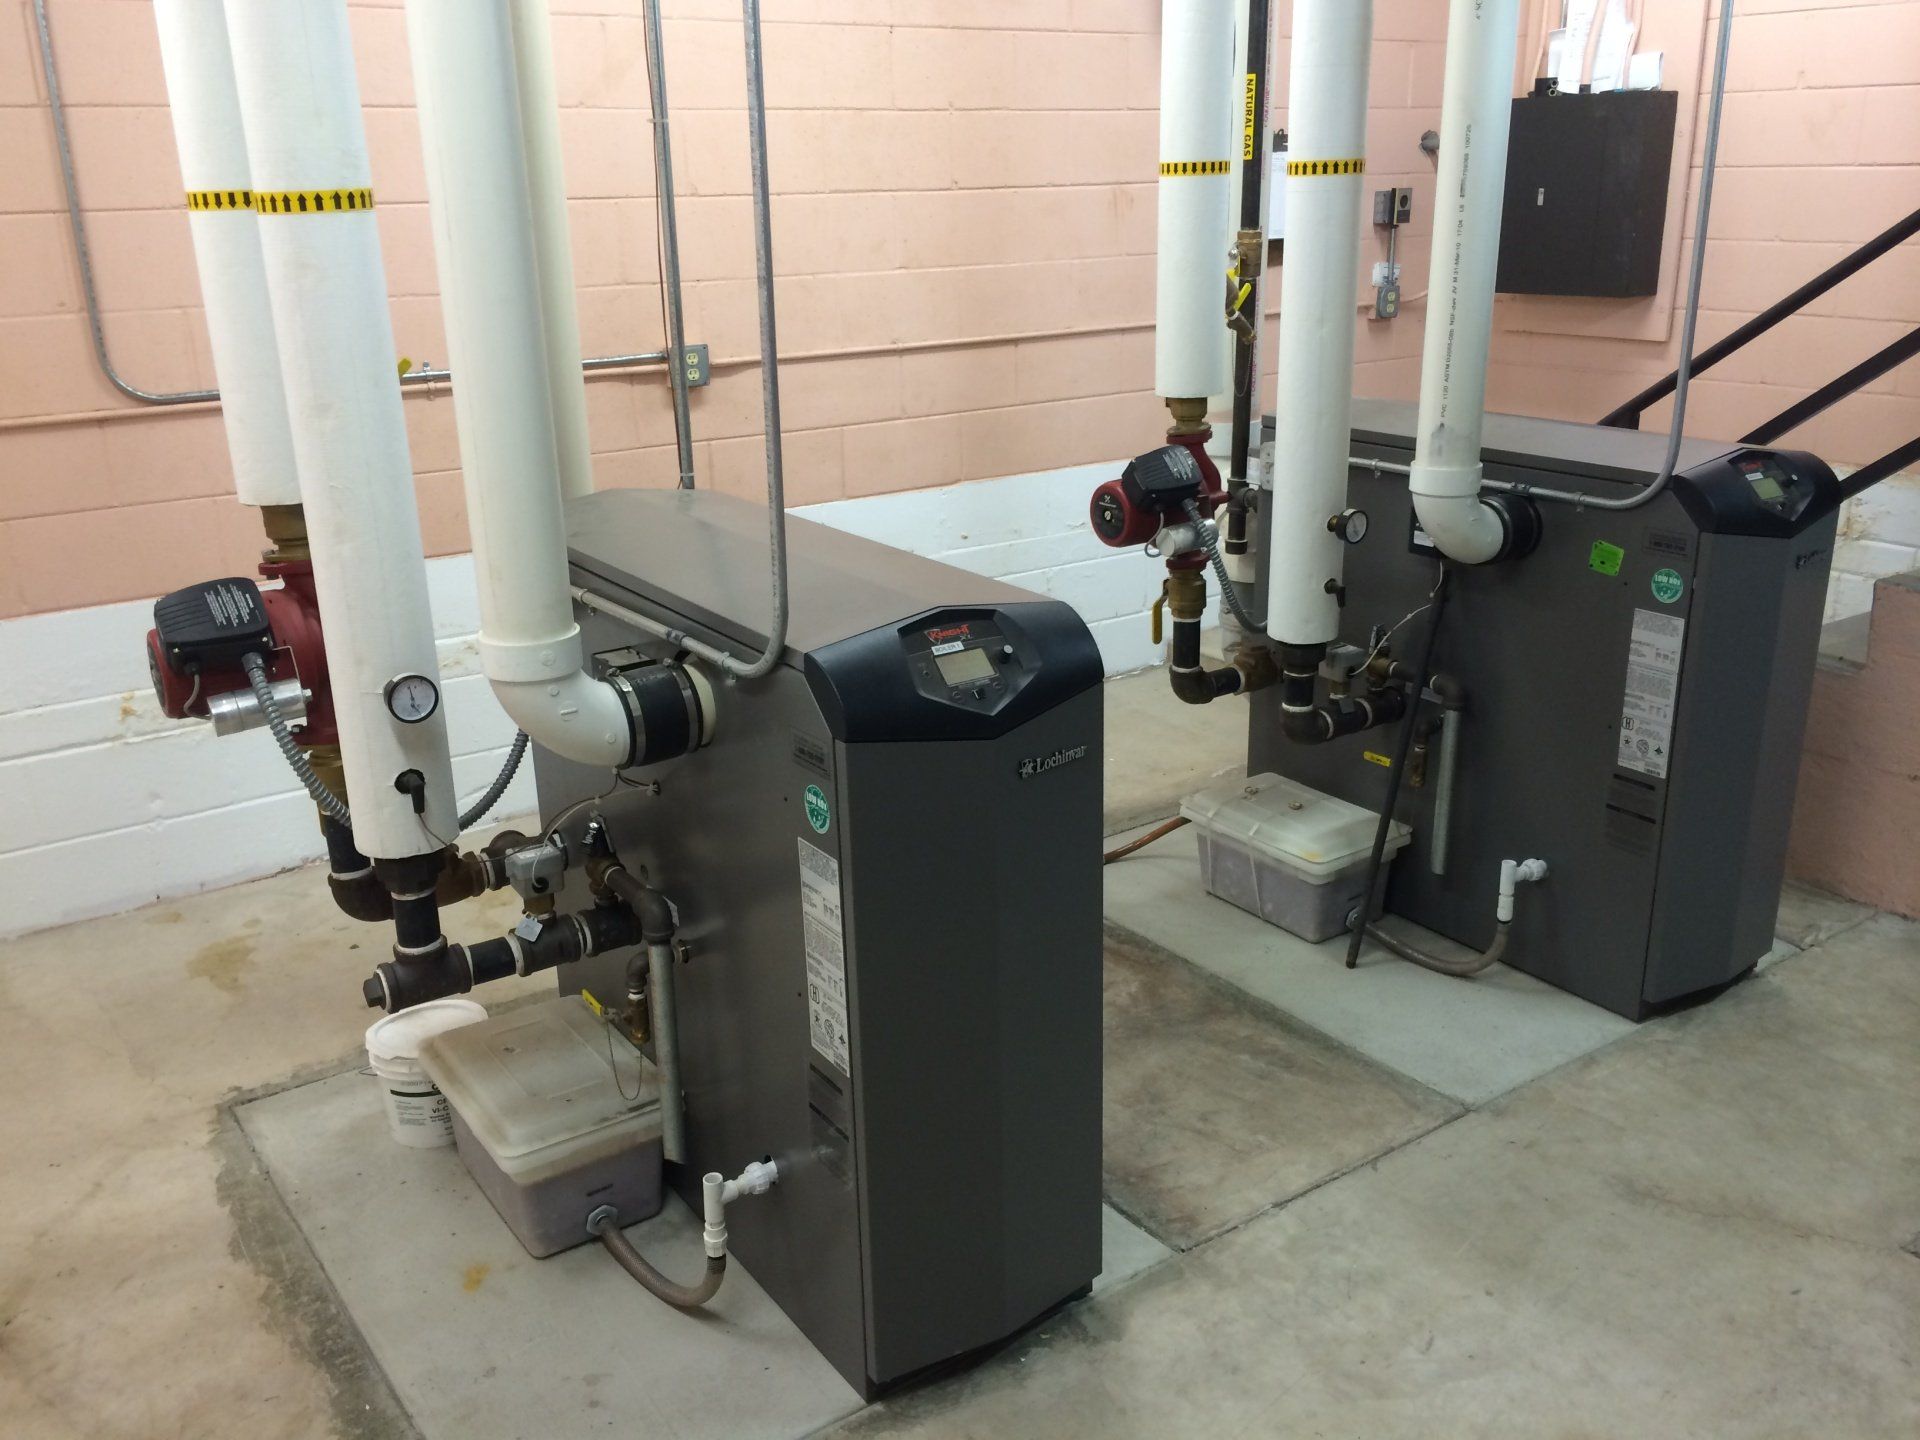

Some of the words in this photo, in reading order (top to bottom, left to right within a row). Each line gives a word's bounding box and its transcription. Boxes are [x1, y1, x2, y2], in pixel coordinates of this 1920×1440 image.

[1245, 78, 1254, 131] NATURAL
[1243, 134, 1252, 157] GAS
[1440, 404, 1448, 418] PVC
[1655, 574, 1668, 583] LOW
[1035, 745, 1088, 773] Lochinvar
